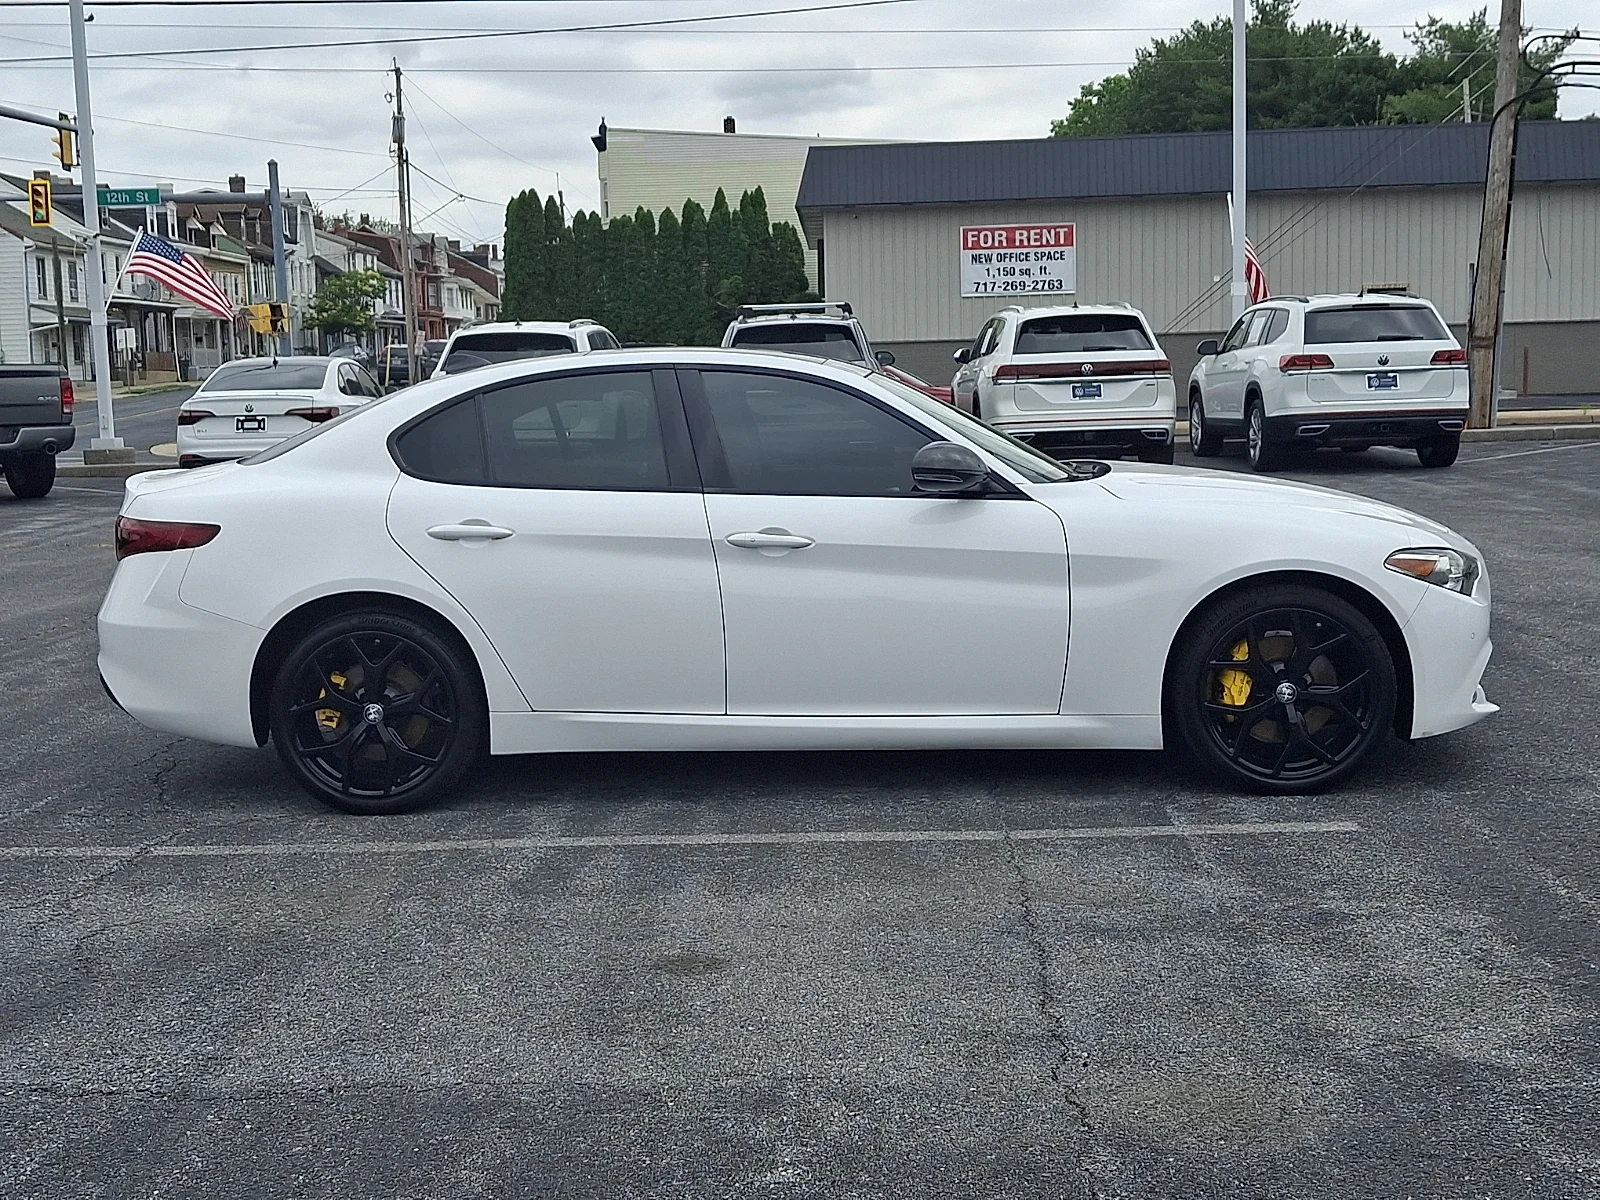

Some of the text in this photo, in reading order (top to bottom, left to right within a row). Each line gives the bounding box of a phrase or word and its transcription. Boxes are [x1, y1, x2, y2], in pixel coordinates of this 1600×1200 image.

[105, 191, 150, 203] 12th St
[967, 227, 1069, 248] FOR RENT
[971, 250, 1066, 265] NEW OFFICE SPACE
[985, 265, 1052, 279] 1,150 sq. ft.
[973, 279, 1064, 293] 717-269-2763
